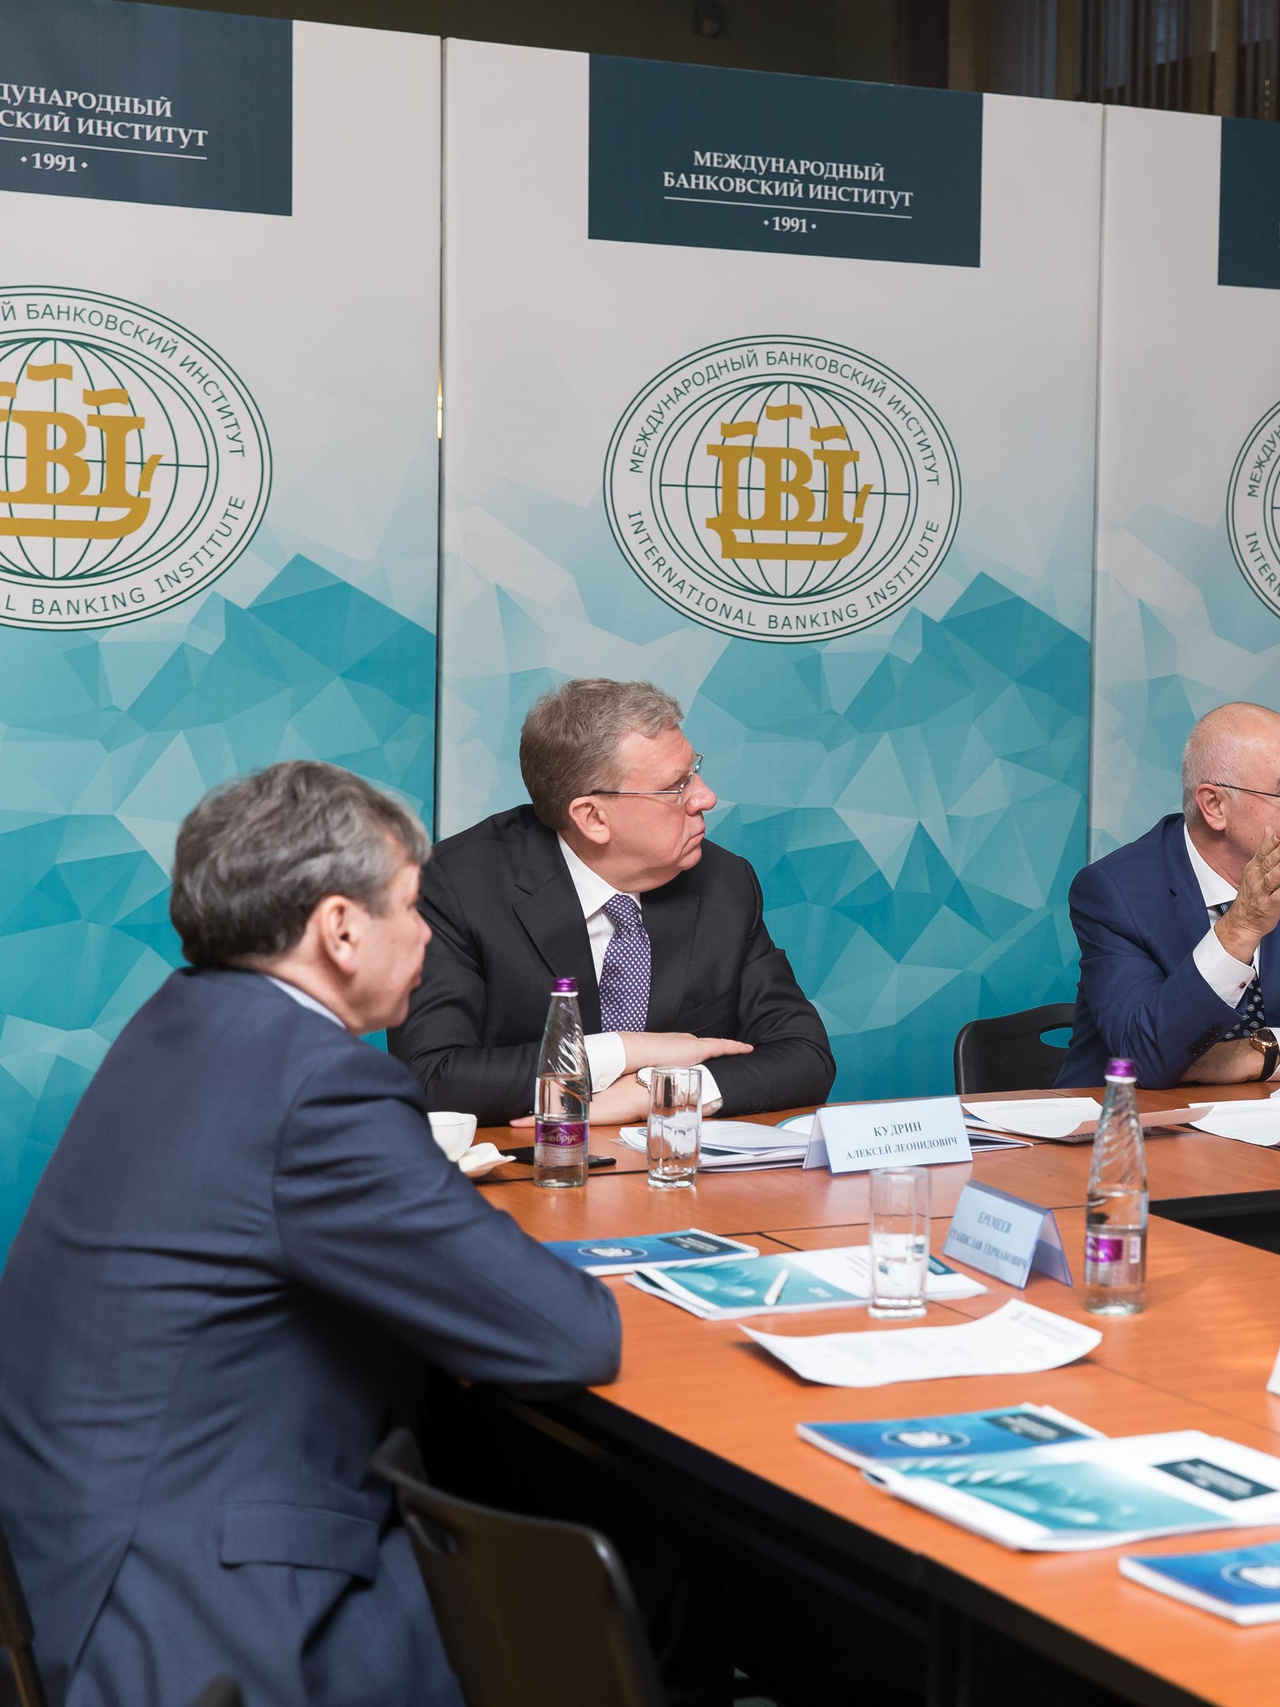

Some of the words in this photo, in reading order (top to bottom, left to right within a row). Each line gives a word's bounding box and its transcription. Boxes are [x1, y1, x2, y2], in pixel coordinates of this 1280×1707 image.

[77, 117, 209, 149] ИНСТИТУТ
[31, 152, 77, 173] 1991
[693, 150, 885, 182] МЕЖДУНАРОДНЫЙ
[663, 171, 803, 198] БАНКОВСКИЙ
[808, 184, 914, 210] ИНСТИТУТ
[771, 216, 808, 234] 1991
[26, 303, 180, 359] БАНКОВСКИЙ
[179, 355, 246, 458] ИНСТИТУТ
[629, 349, 759, 474] МЕЖДУНАРОДНЫЙ
[766, 350, 887, 399] БАНКОВСКИЙ
[887, 394, 940, 486] ИНСТИТУТ
[32, 587, 146, 616] BANKING
[154, 496, 246, 594] INSTITUTE
[628, 511, 756, 627] INTERNATIONAL
[768, 603, 859, 630] BANKING
[866, 520, 939, 610] INSTITUTE
[873, 1121, 922, 1137] КУДРИН
[846, 1144, 892, 1160] АЛЕКСЕЙ
[893, 1137, 958, 1153] ЛЕОНИДОВИЧ
